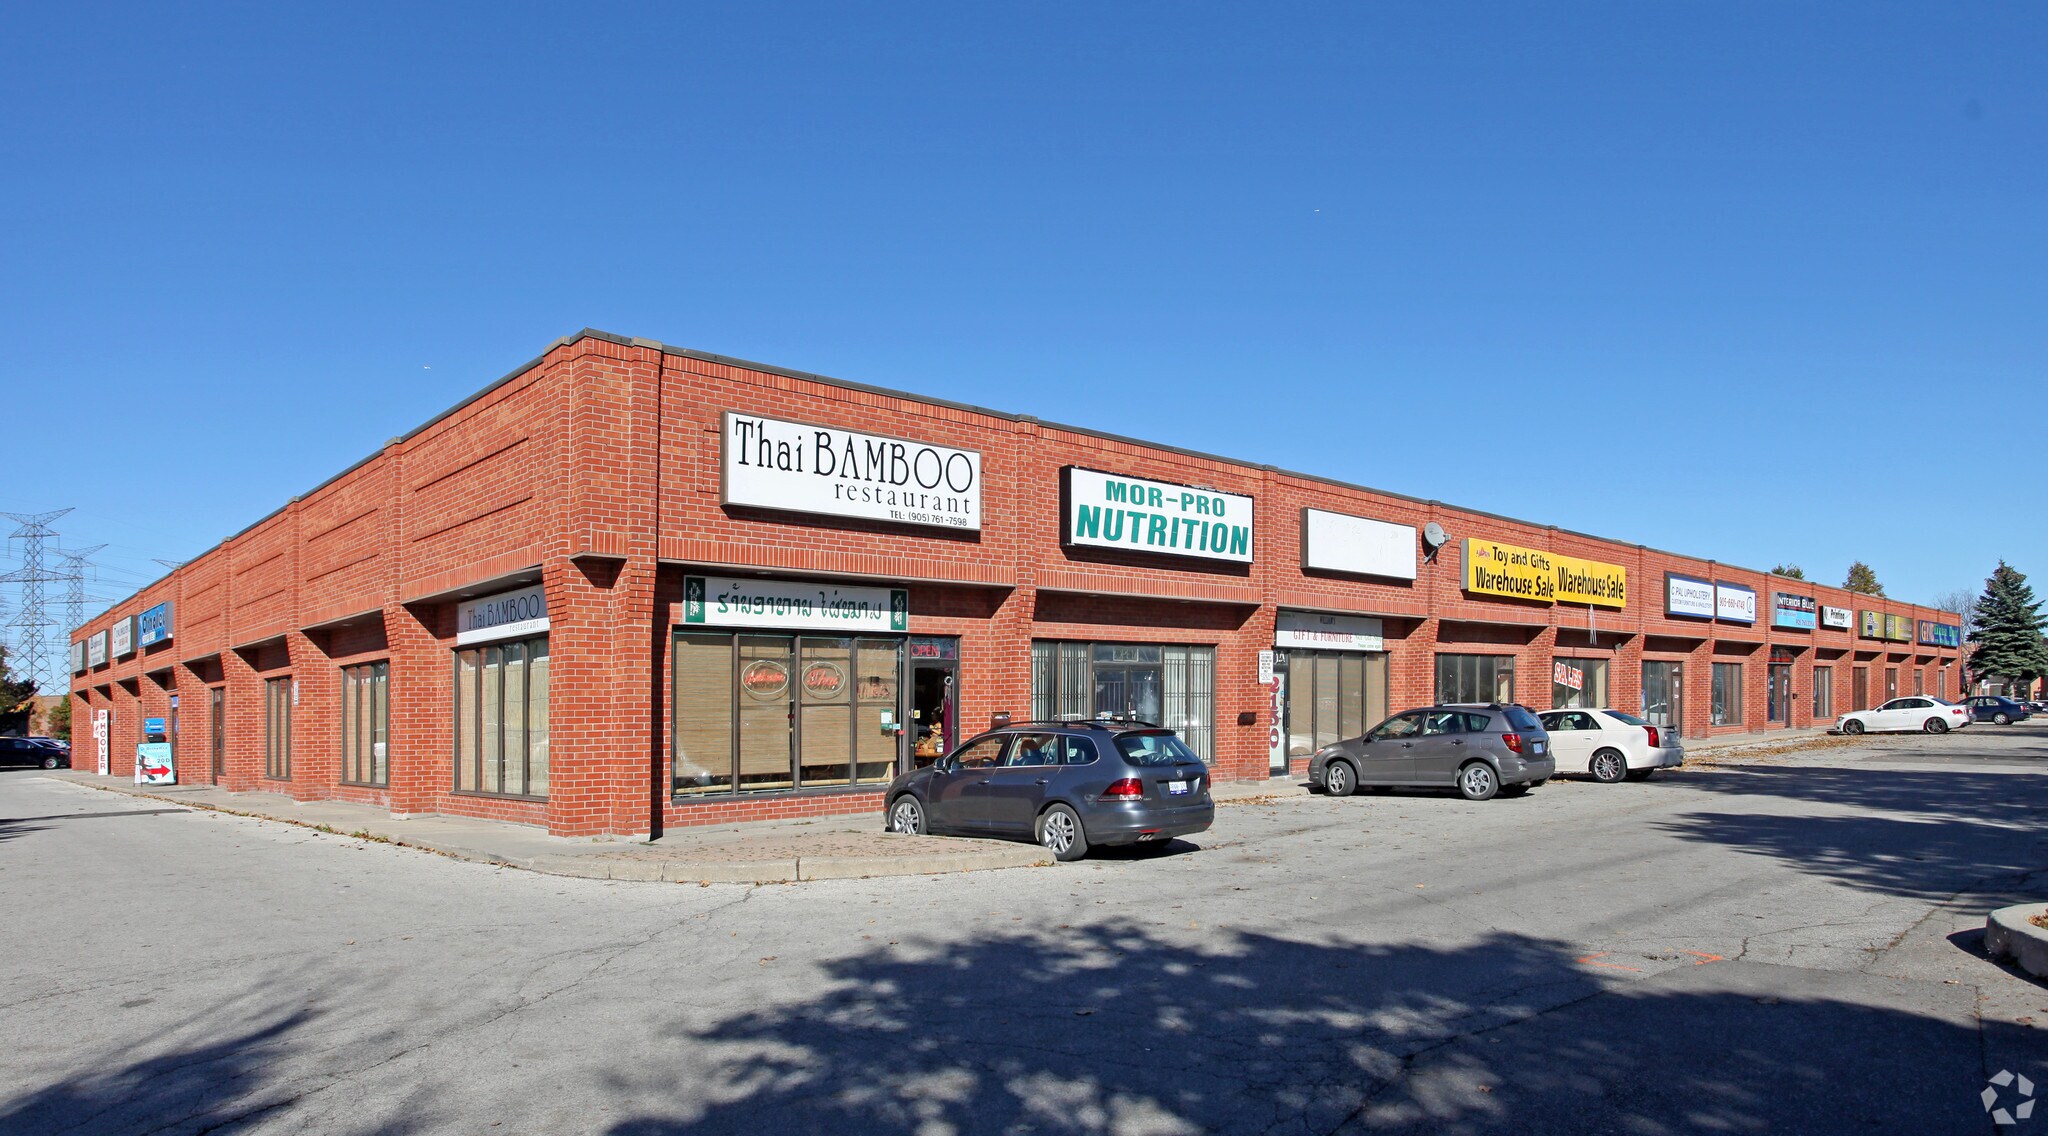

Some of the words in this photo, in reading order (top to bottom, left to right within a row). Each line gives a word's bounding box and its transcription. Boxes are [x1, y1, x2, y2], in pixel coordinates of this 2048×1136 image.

[736, 418, 803, 472] Thai
[814, 431, 973, 493] BAMBOO
[834, 483, 971, 514] restaurant
[1106, 480, 1225, 517] MOR-PRO
[889, 510, 905, 520] TEL:
[908, 512, 930, 523] (905)
[1076, 504, 1248, 555] NUTRITION
[1493, 546, 1508, 566] Toy
[1511, 552, 1527, 566] and
[1531, 553, 1550, 571] Gifts
[1475, 566, 1532, 595] Warehouse
[1535, 575, 1554, 598] Sale
[1558, 566, 1606, 597] Warehouse
[1607, 574, 1624, 599] Sale
[467, 608, 485, 629] Thai
[487, 594, 539, 626] BAMBOO
[1801, 598, 1815, 610] BLUE
[911, 645, 939, 656] OPEN
[1293, 629, 1310, 641] GIFT
[1320, 630, 1353, 643] FURNITURE
[1554, 662, 1583, 690] SALES
